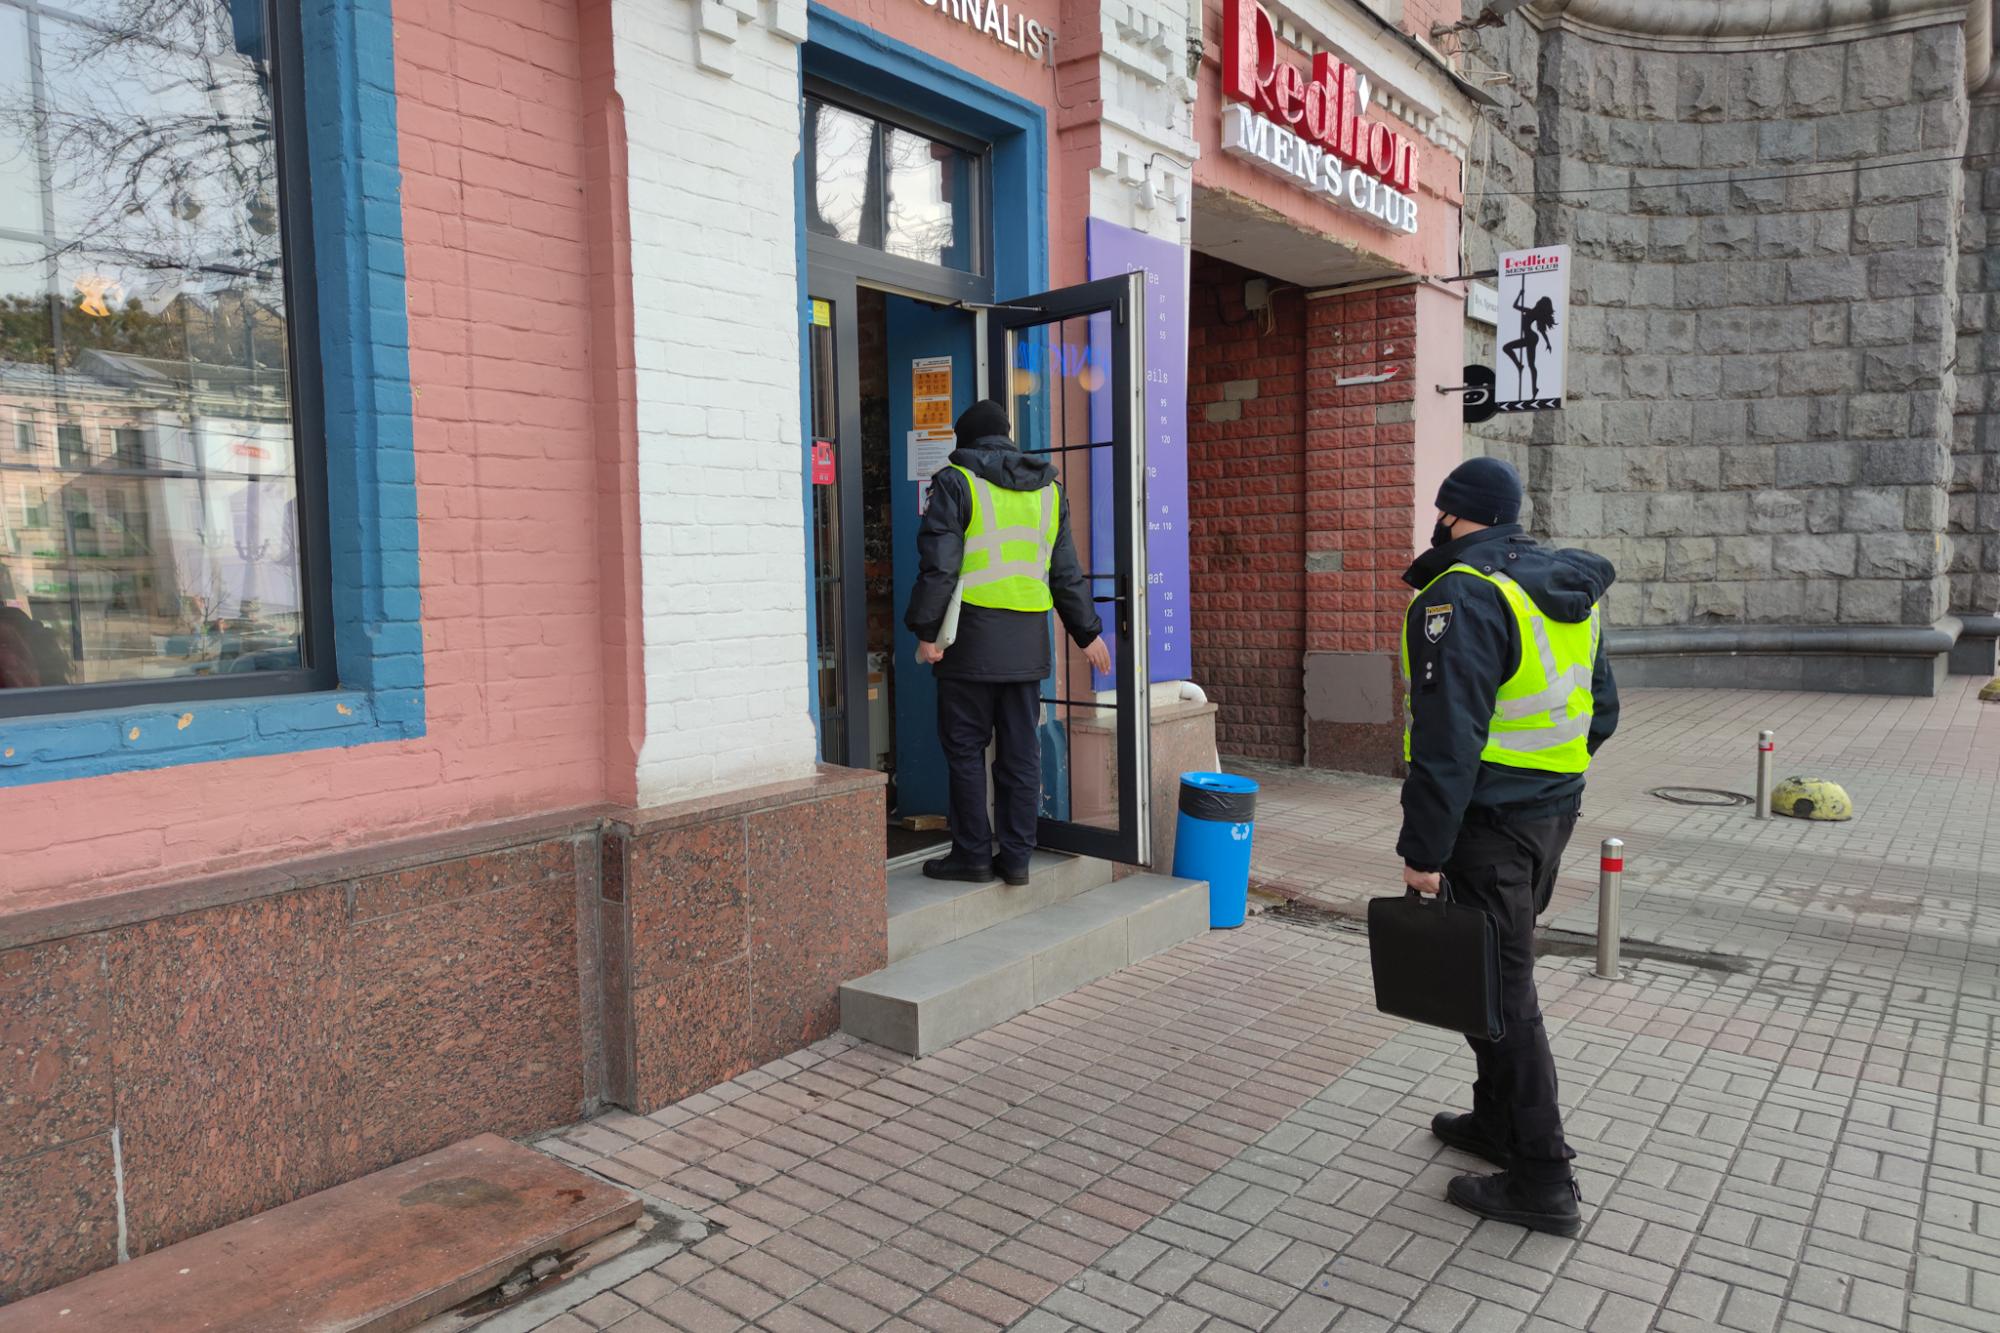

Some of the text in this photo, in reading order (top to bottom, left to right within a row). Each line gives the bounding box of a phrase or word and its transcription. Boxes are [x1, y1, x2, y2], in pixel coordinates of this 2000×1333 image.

[1224, 0, 1420, 193] Redlion
[1236, 106, 1418, 234] MEN'S CLUB
[1505, 254, 1559, 269] Redlion
[1505, 266, 1533, 274] MEN'S
[1147, 368, 1168, 384] ails
[1164, 591, 1173, 601] 120
[1164, 608, 1173, 617] 125
[1164, 625, 1174, 634] 110
